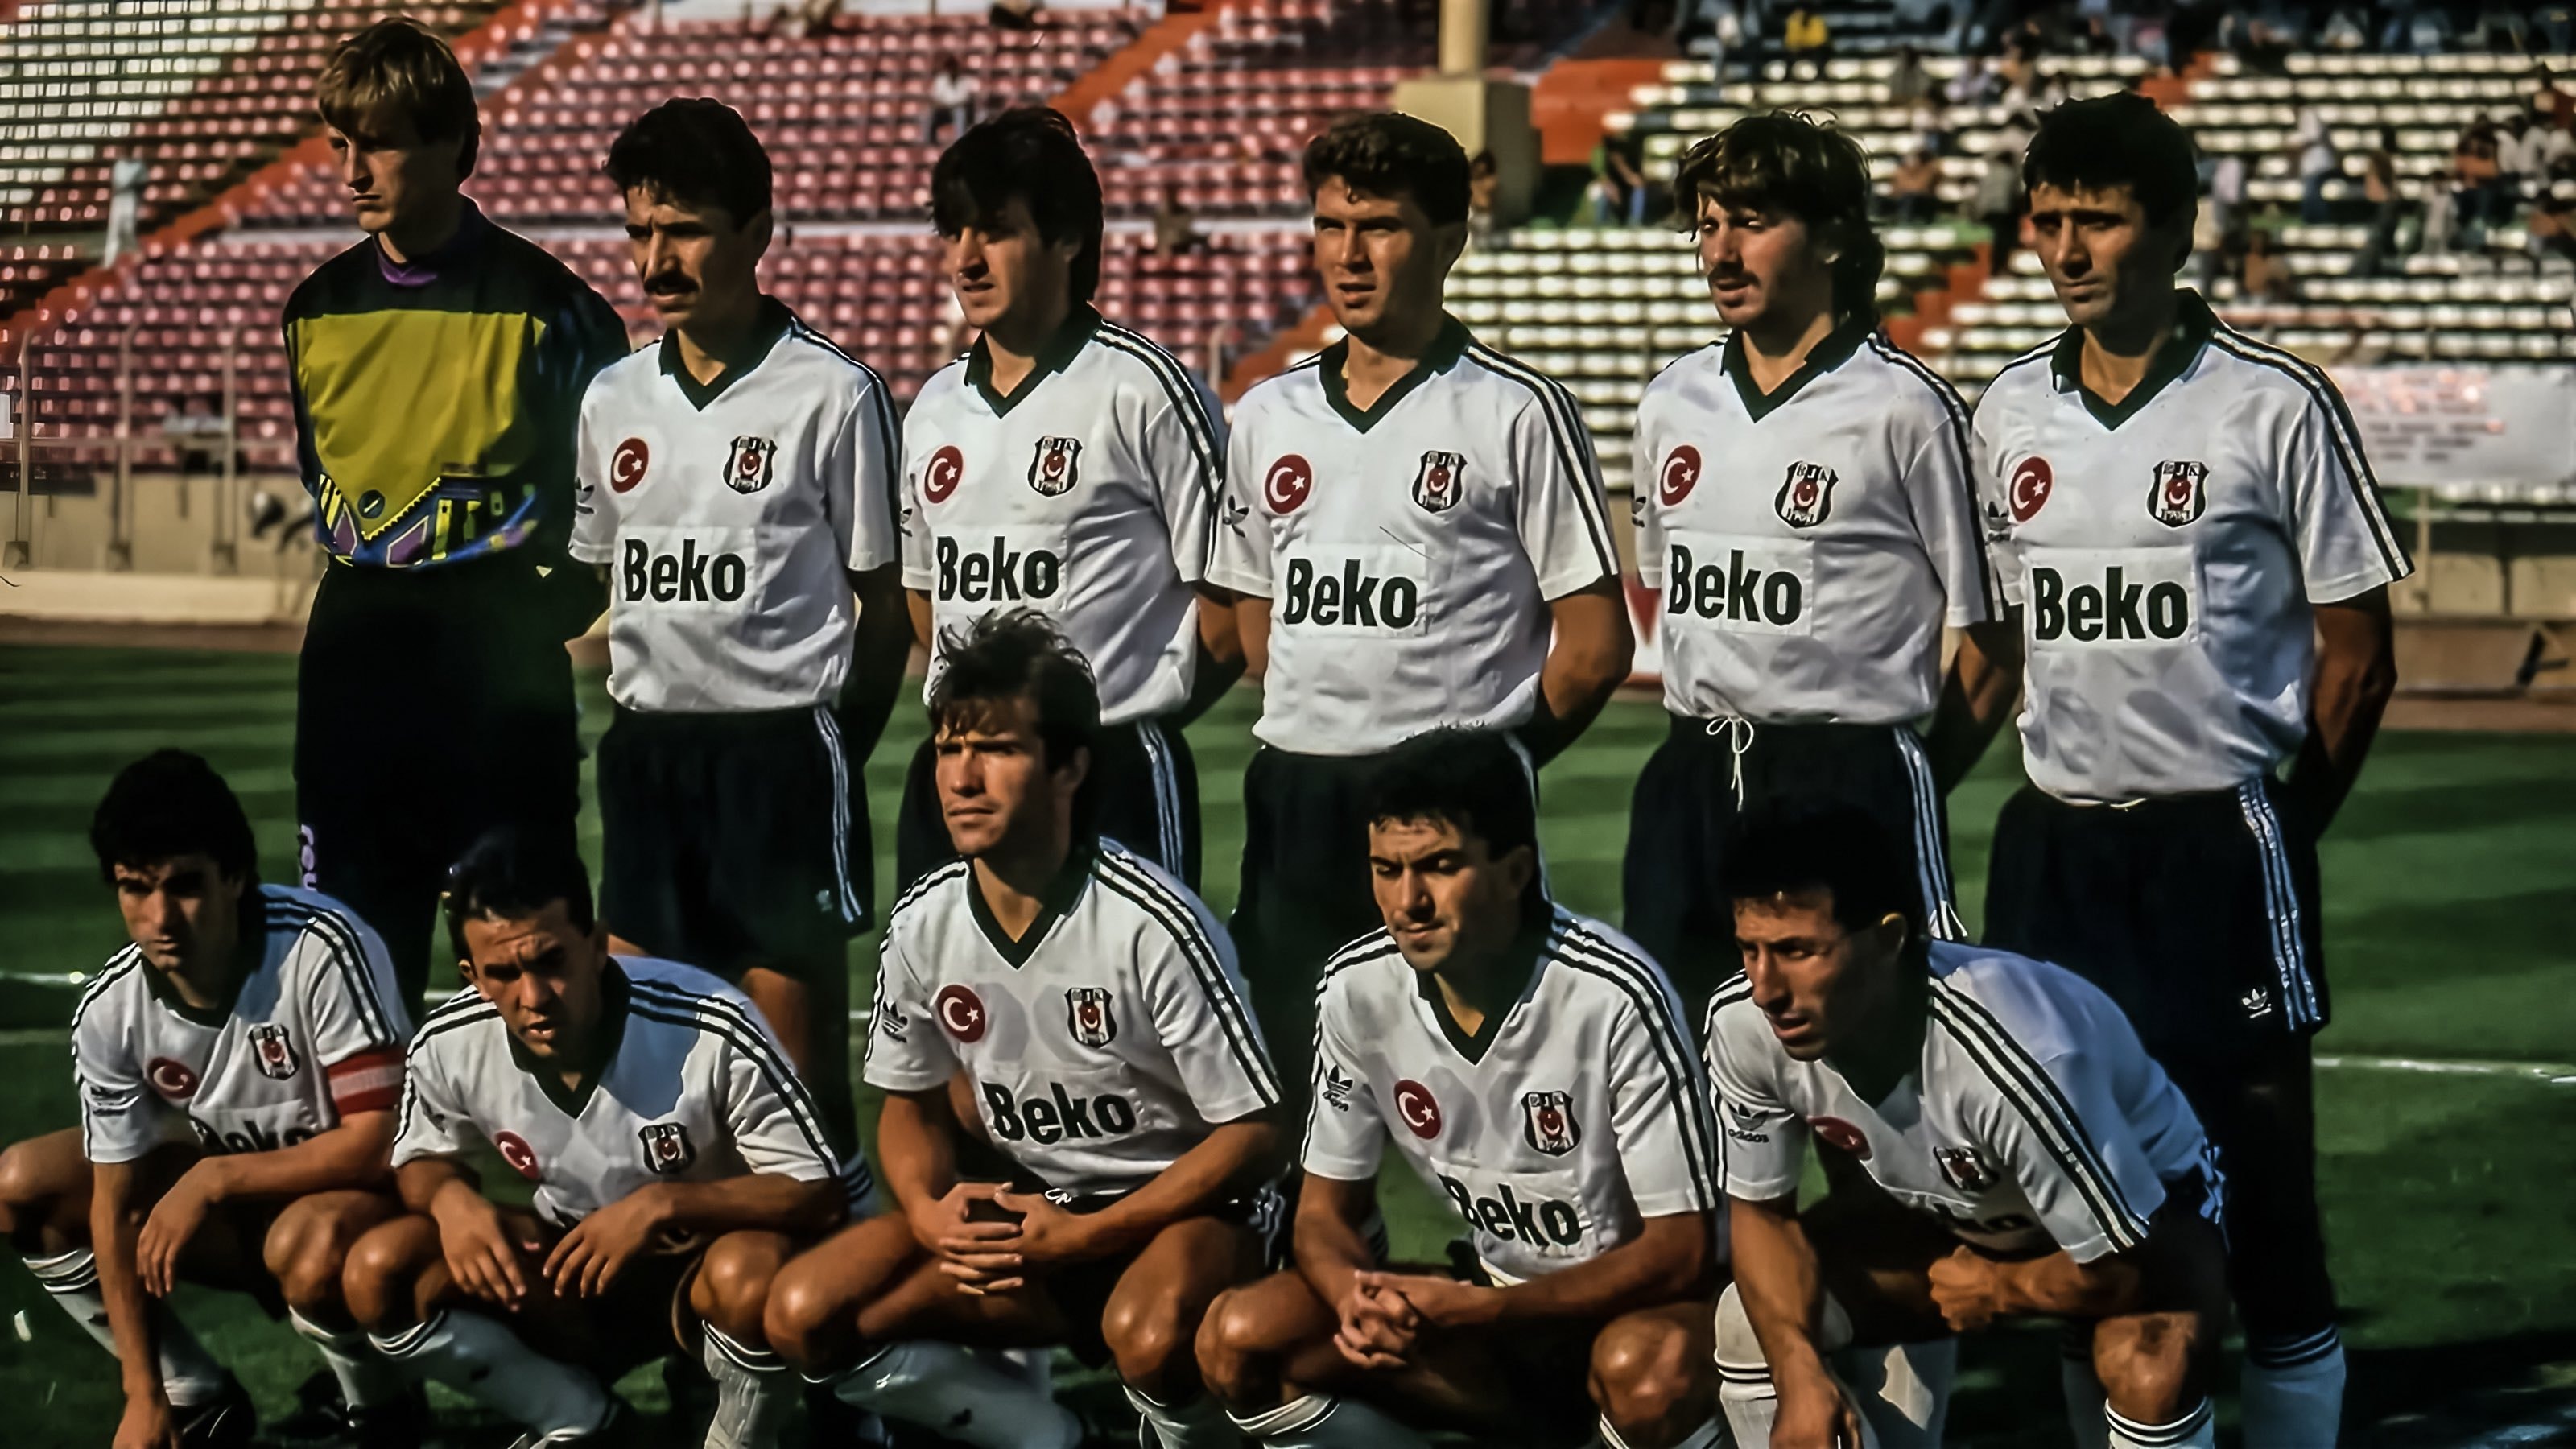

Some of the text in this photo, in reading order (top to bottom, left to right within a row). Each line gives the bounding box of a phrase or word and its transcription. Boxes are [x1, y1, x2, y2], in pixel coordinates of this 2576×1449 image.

[624, 539, 746, 602] Beko
[937, 536, 1061, 602] Beko
[1283, 559, 1418, 628] Beko
[1667, 544, 1802, 626] Beko
[2033, 566, 2189, 642] Beko
[980, 1081, 1137, 1146] Beko
[1436, 1173, 1583, 1247] Beko
